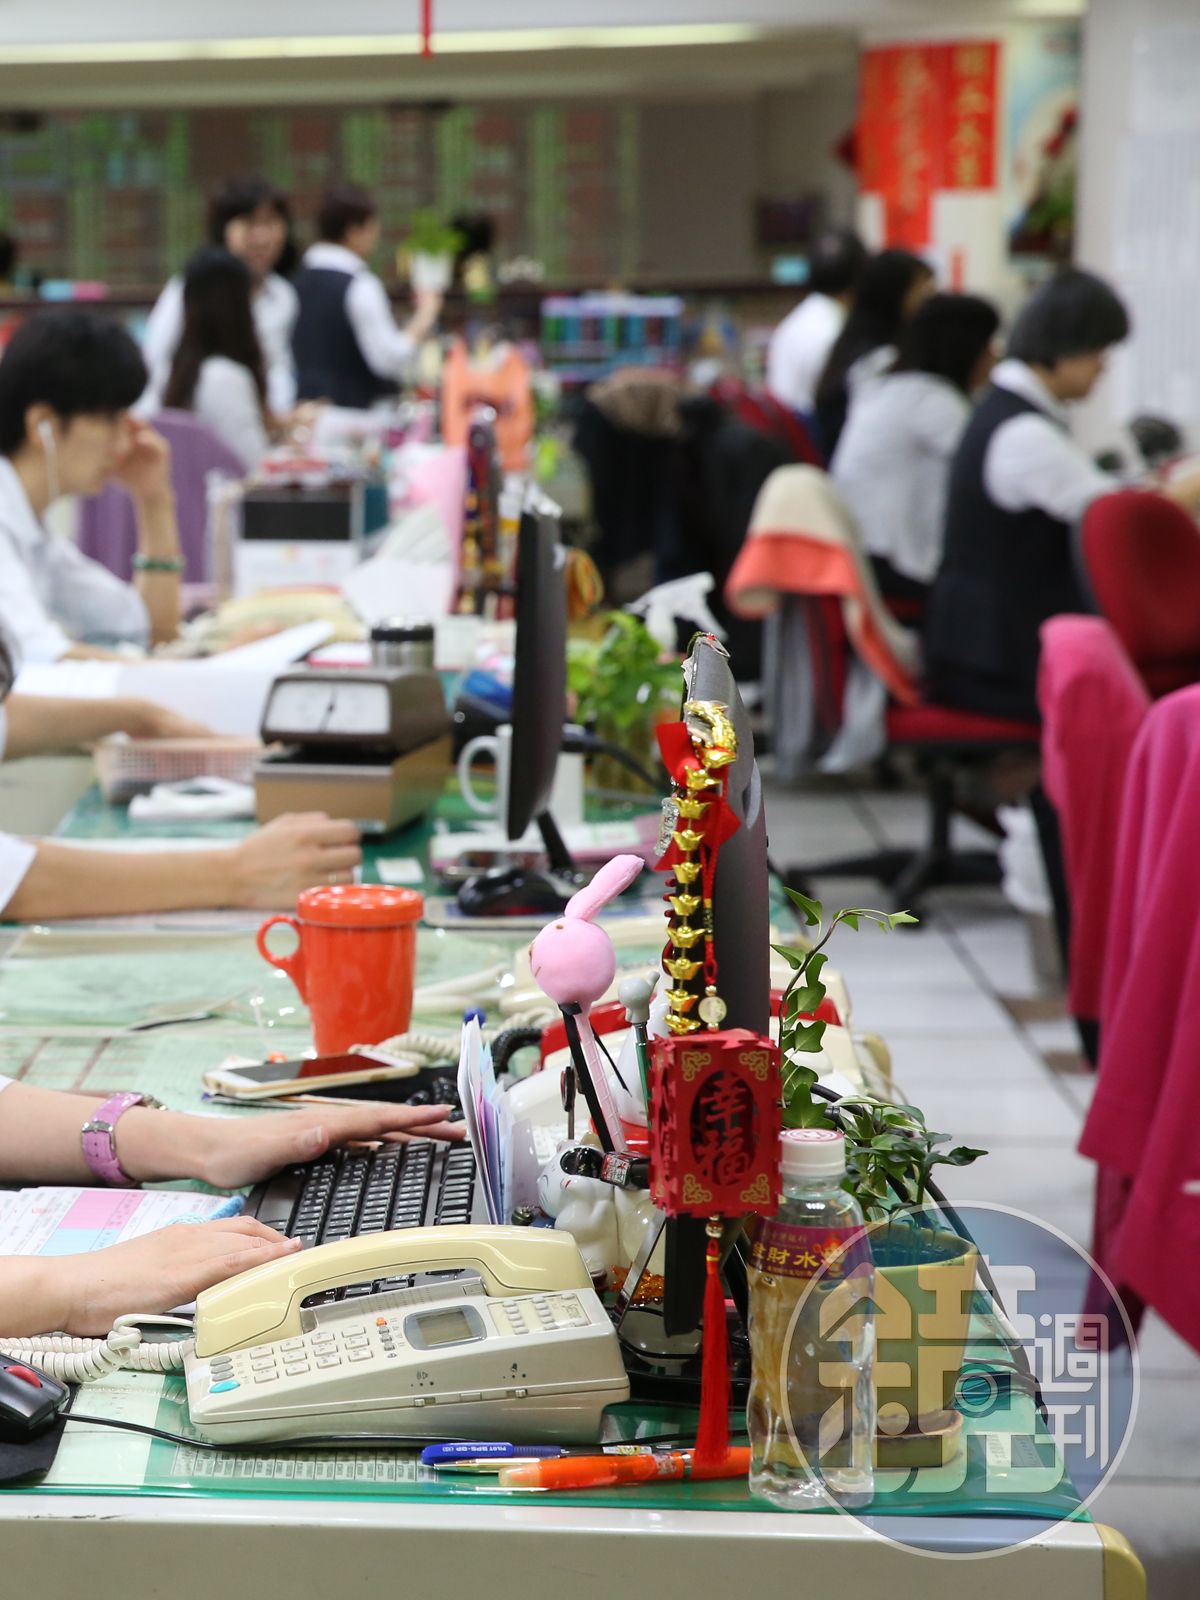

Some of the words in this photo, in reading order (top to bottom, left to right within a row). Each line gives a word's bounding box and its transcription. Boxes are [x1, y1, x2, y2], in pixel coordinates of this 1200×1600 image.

[696, 1072, 748, 1186] 幸福
[752, 1241, 820, 1268] 發財水
